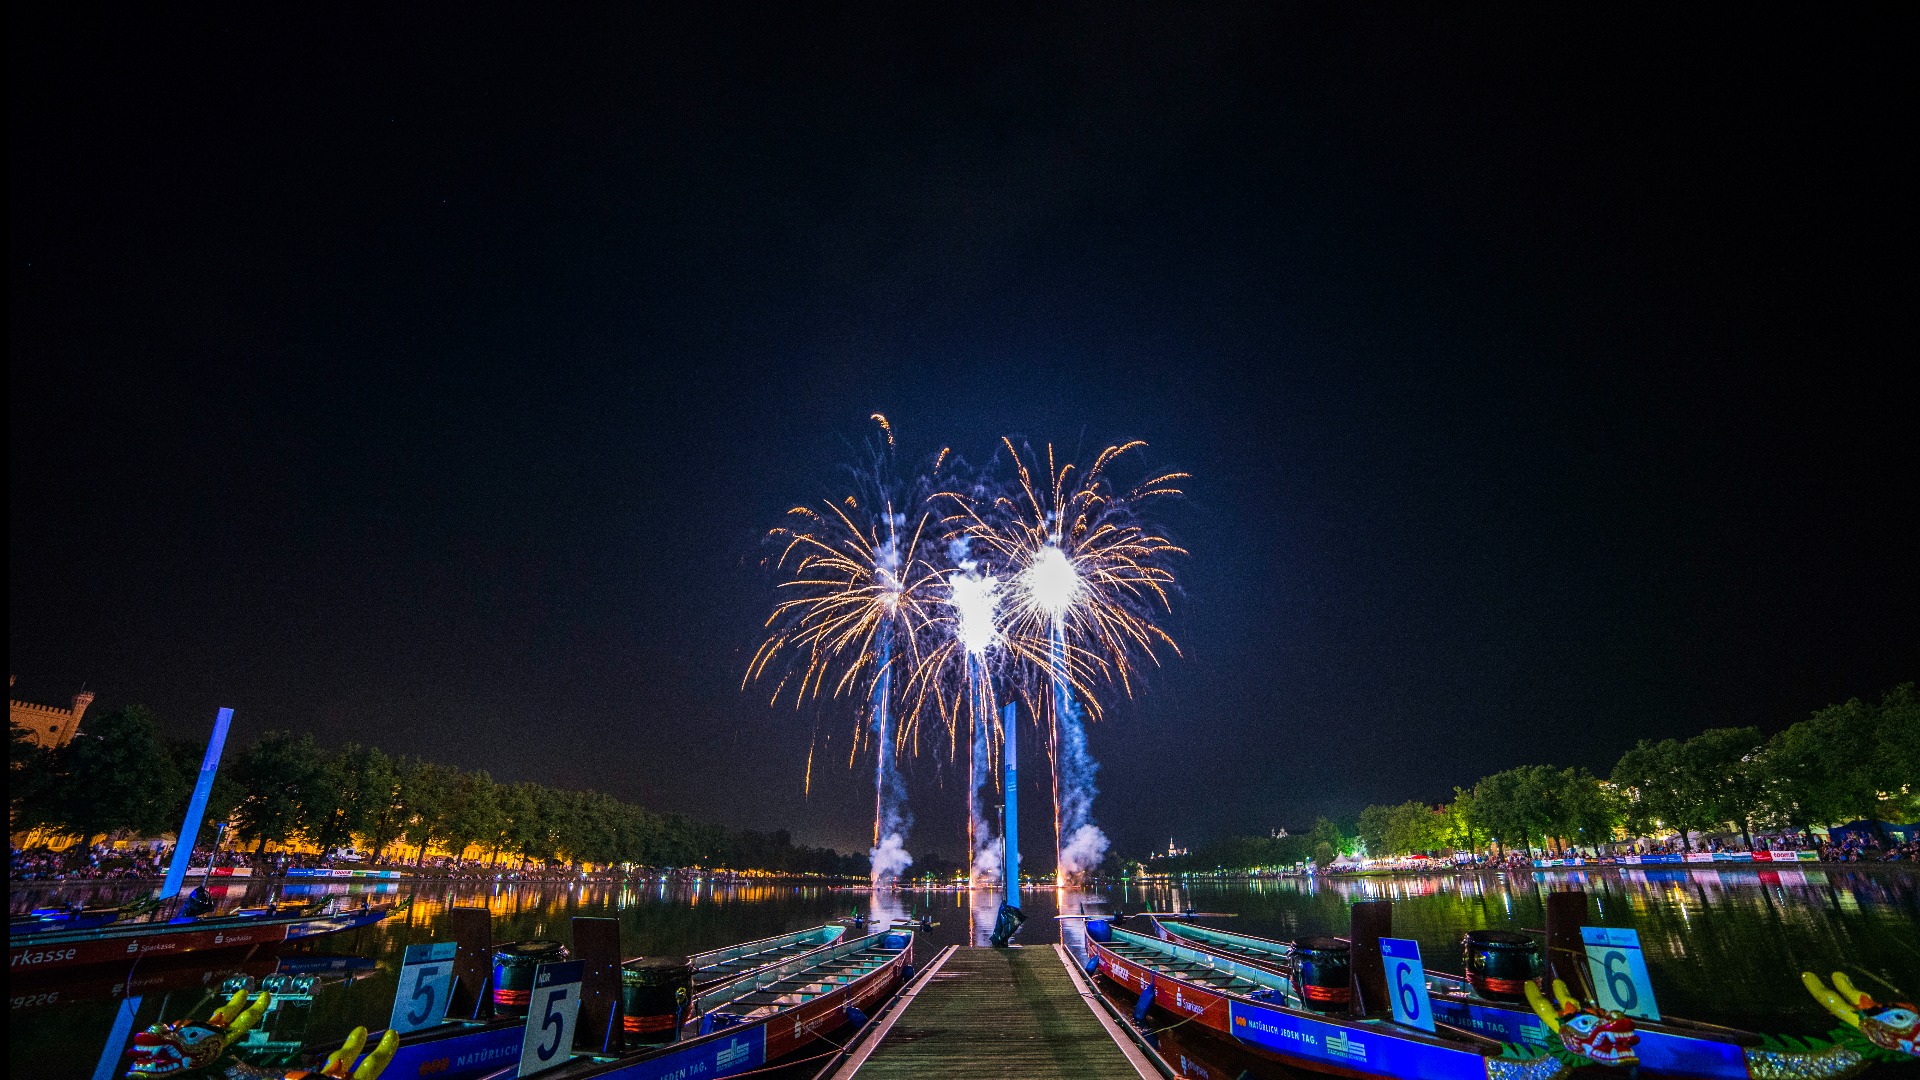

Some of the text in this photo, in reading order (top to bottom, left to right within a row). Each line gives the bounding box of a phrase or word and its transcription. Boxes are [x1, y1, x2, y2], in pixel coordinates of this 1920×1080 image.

[141, 943, 176, 952] Sparkasse
[225, 935, 253, 943] Sparkasse
[1396, 962, 1420, 1021] 6
[1604, 951, 1638, 1010] 6
[408, 966, 440, 1026] 5
[537, 989, 568, 1061] 5
[1248, 1020, 1318, 1045] NATÜRLICH JEDEN TAG.
[1458, 1017, 1484, 1029] JEDEN
[1487, 1021, 1509, 1034] TAG.
[456, 1044, 518, 1067] NATÜRLICH
[689, 1062, 707, 1076] TAG.
